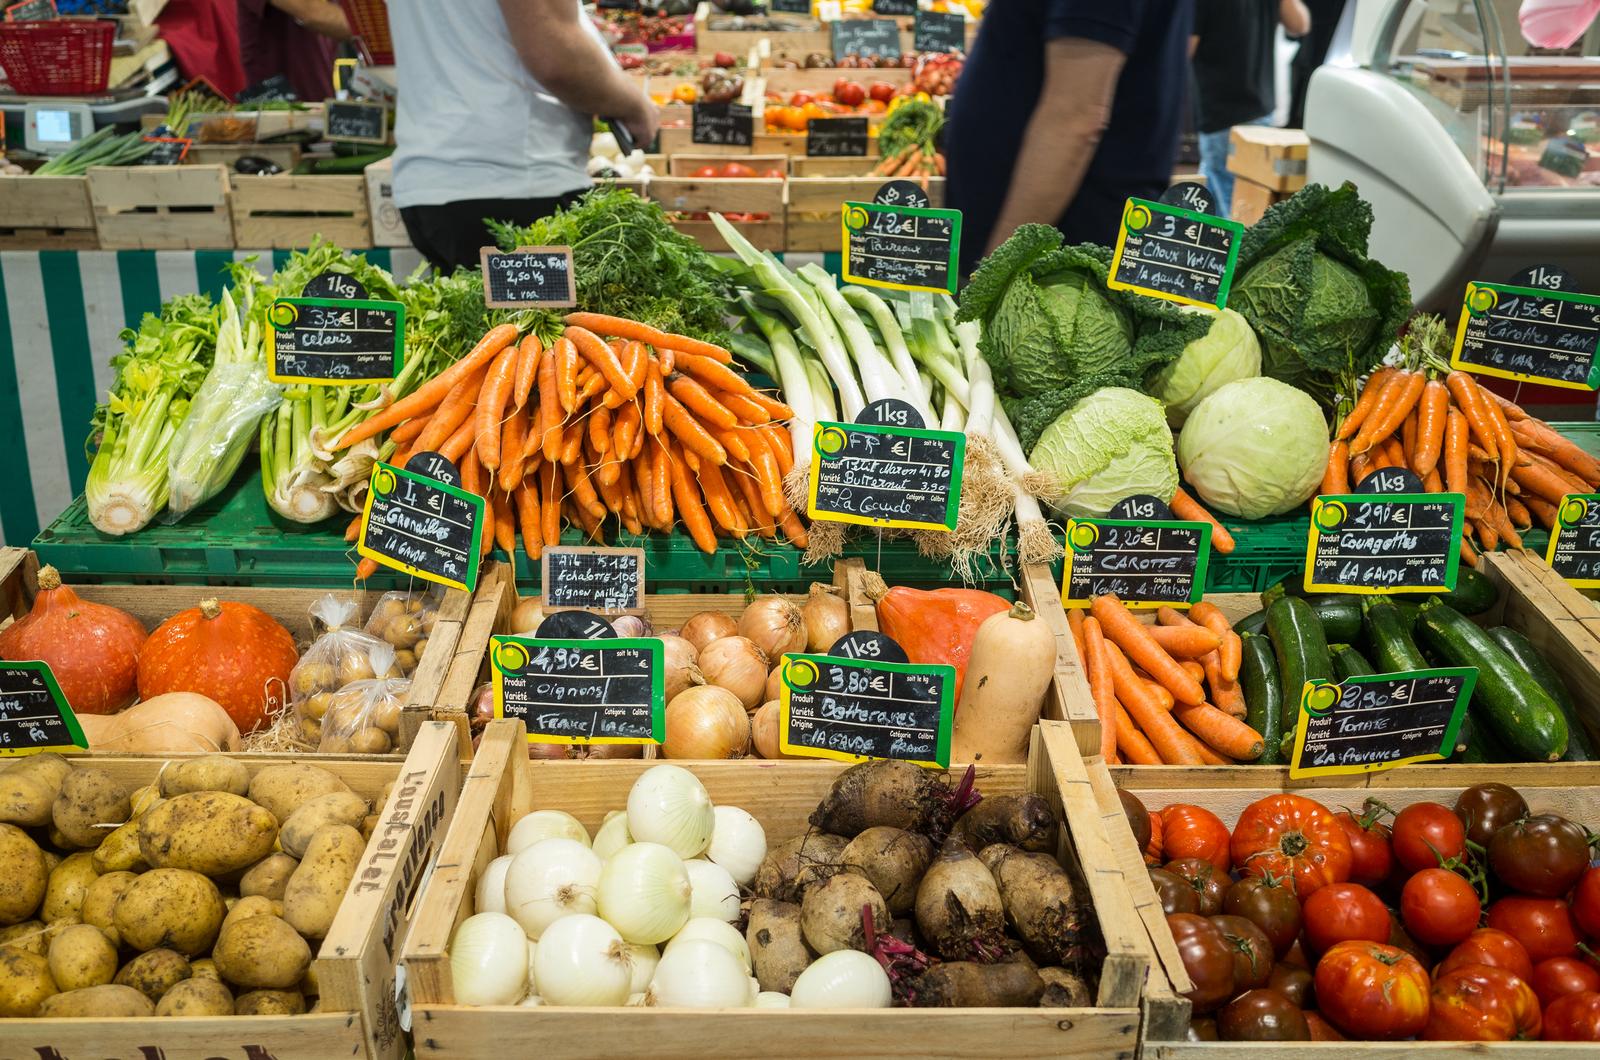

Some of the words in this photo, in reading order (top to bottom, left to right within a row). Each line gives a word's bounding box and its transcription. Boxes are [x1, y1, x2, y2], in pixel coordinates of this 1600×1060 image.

[1184, 187, 1208, 213] 1kg
[507, 270, 530, 285] 2,50
[1528, 268, 1562, 289] 1kg
[328, 276, 357, 298] 1kg
[875, 402, 907, 425] 1kg
[822, 460, 841, 469] Produit
[427, 457, 454, 485] 1kg
[820, 473, 840, 482] Variété
[1371, 472, 1405, 493] 1kg
[820, 486, 839, 495] Origine
[1122, 500, 1154, 518] 1kg
[1320, 534, 1340, 543] Produit
[1101, 554, 1181, 570] CAROTTE
[1317, 559, 1337, 568] Origine
[841, 637, 880, 659] 1kg
[505, 678, 526, 687] Produit
[505, 691, 528, 700] Variété
[792, 694, 814, 703] Produit
[506, 705, 528, 716] Origine
[791, 707, 814, 716] Variété
[791, 720, 813, 730] Origine
[1310, 718, 1332, 726] Produit
[1308, 732, 1330, 740] Variété
[1305, 744, 1328, 752] Origine
